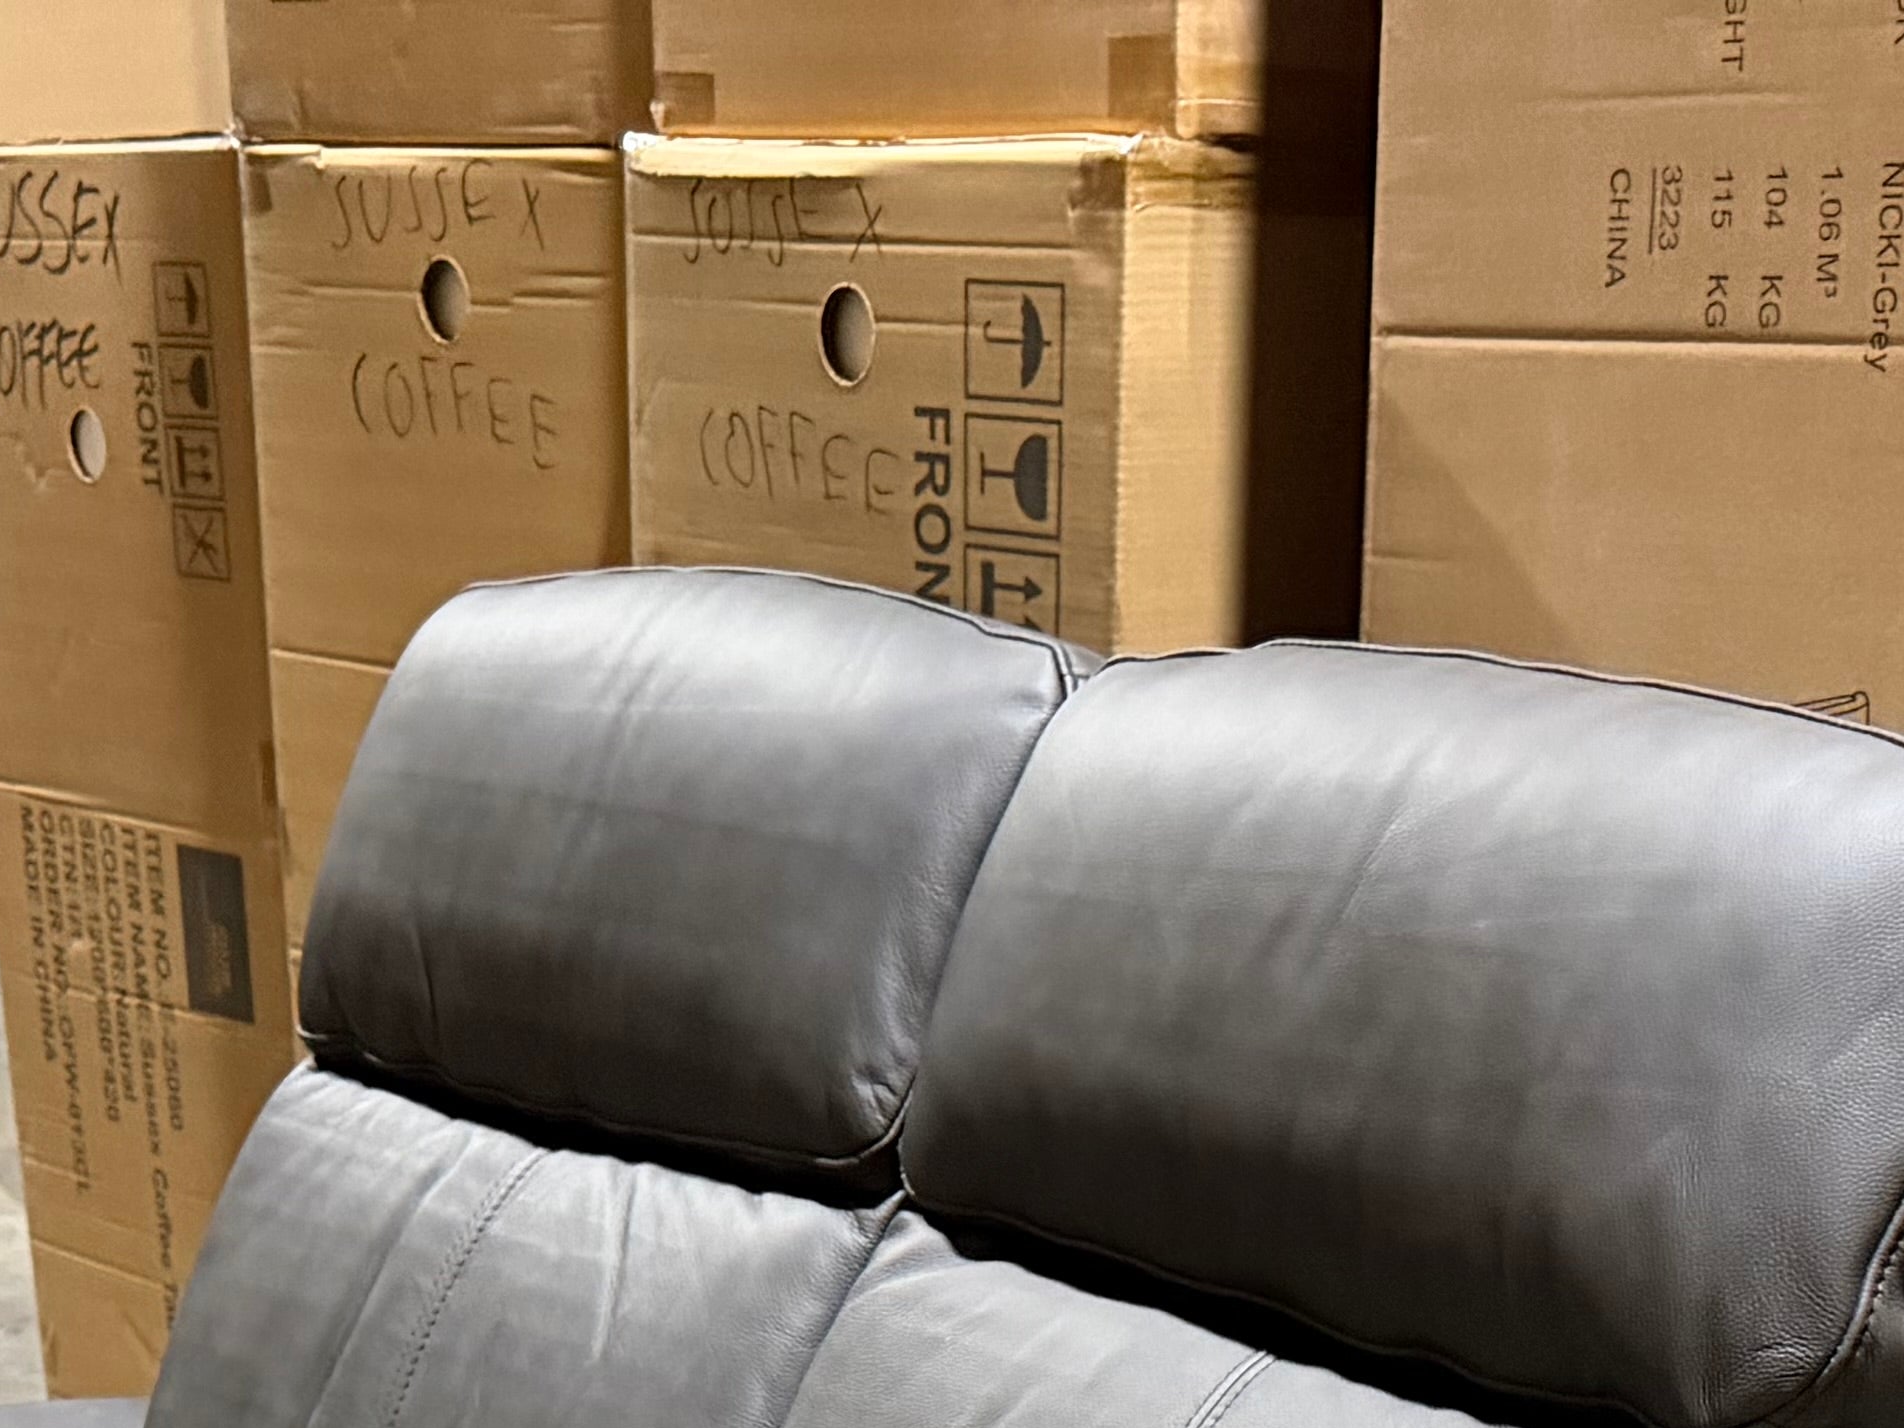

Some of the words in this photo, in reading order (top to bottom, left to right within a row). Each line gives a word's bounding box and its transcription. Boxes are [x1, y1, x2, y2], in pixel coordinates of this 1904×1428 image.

[1604, 168, 1632, 289] CHINA
[1658, 164, 1684, 252] 3223
[1709, 168, 1735, 231] 115
[1762, 166, 1789, 231] 104
[1817, 166, 1844, 242] 1.06
[1704, 274, 1729, 330] KG
[1758, 274, 1784, 330] KG
[131, 340, 164, 497] FRONT
[19, 803, 42, 904] MADE
[29, 915, 47, 949] IN
[33, 958, 59, 1062] CHINA
